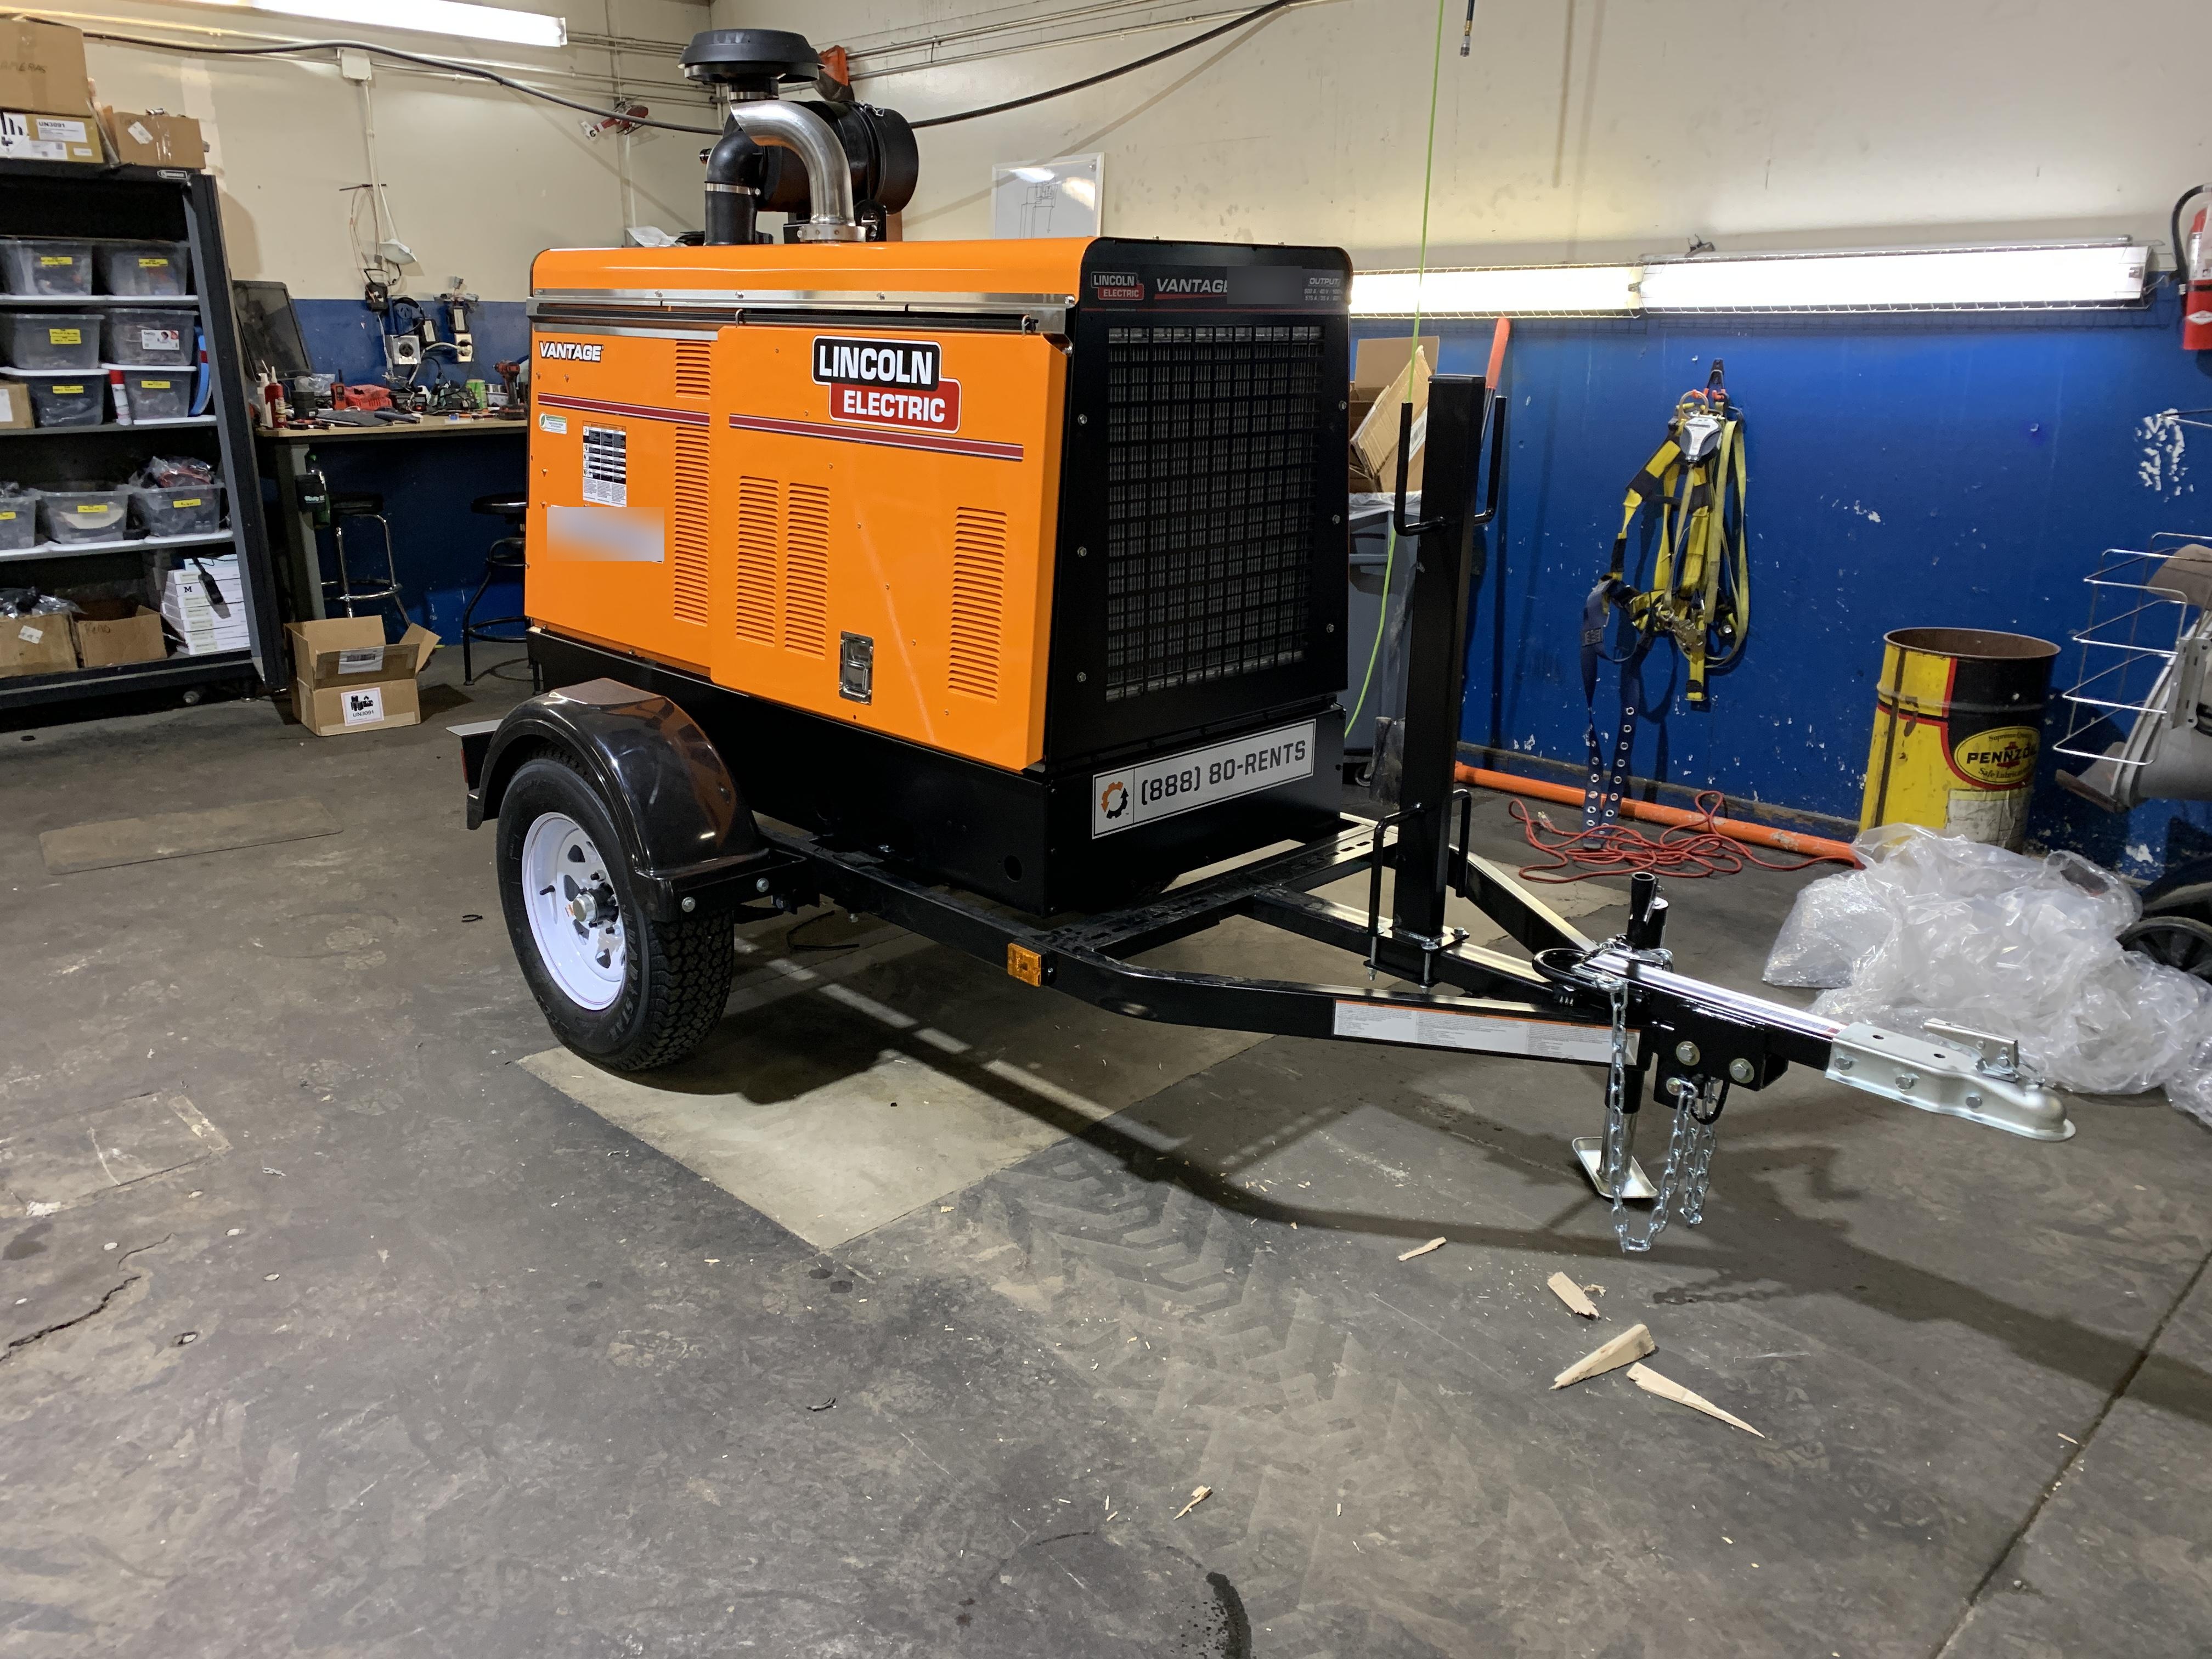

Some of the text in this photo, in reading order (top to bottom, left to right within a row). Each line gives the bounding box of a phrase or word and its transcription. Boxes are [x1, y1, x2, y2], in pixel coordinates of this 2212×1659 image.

[1093, 274, 1135, 286] LINCOLN
[1103, 289, 1139, 297] ELECTRIC
[539, 341, 602, 362] VANTAGE
[819, 345, 933, 385] LINCOLN
[843, 390, 945, 423] ELECTRIC
[1141, 740, 1305, 805] (888) 80-RENTS
[1978, 768, 1995, 778] Safe
